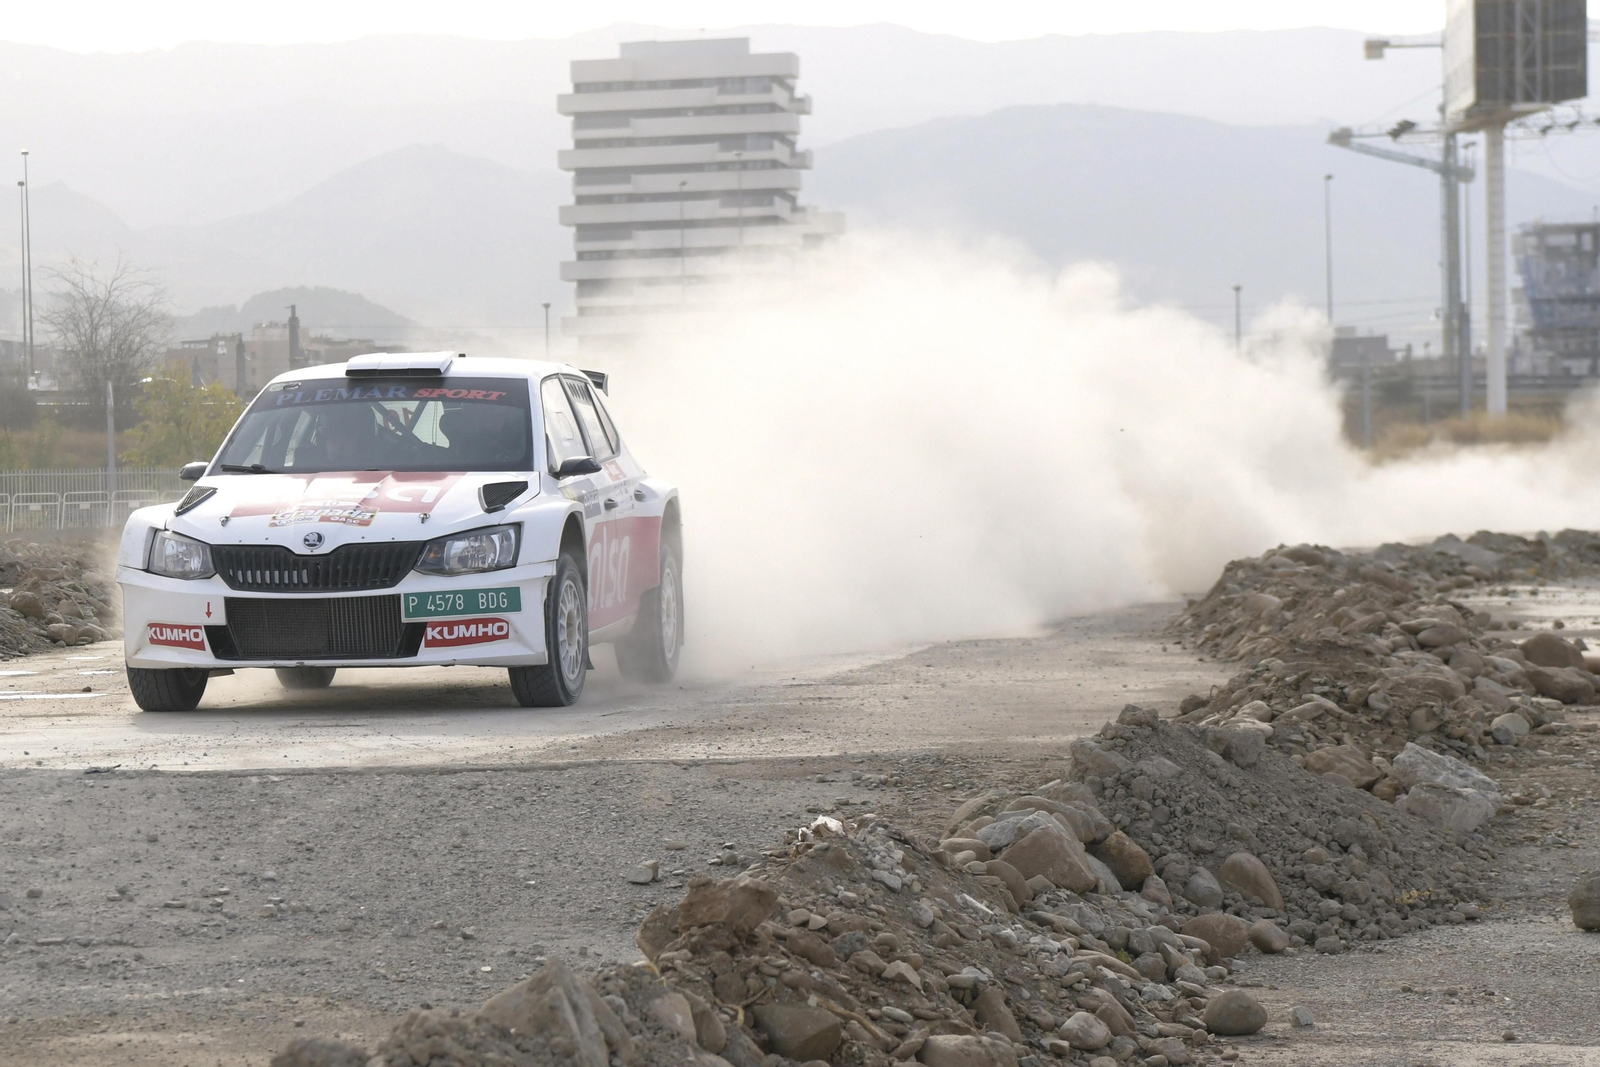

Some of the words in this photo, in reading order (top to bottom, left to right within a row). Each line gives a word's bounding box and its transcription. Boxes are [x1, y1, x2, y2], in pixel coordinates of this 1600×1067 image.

[274, 386, 407, 406] PLEMAR
[413, 388, 506, 400] SPORT
[409, 596, 418, 612] P
[427, 594, 464, 611] 4578
[478, 592, 508, 609] BDG
[147, 626, 203, 642] KUMHO
[426, 621, 508, 640] KUMHO
